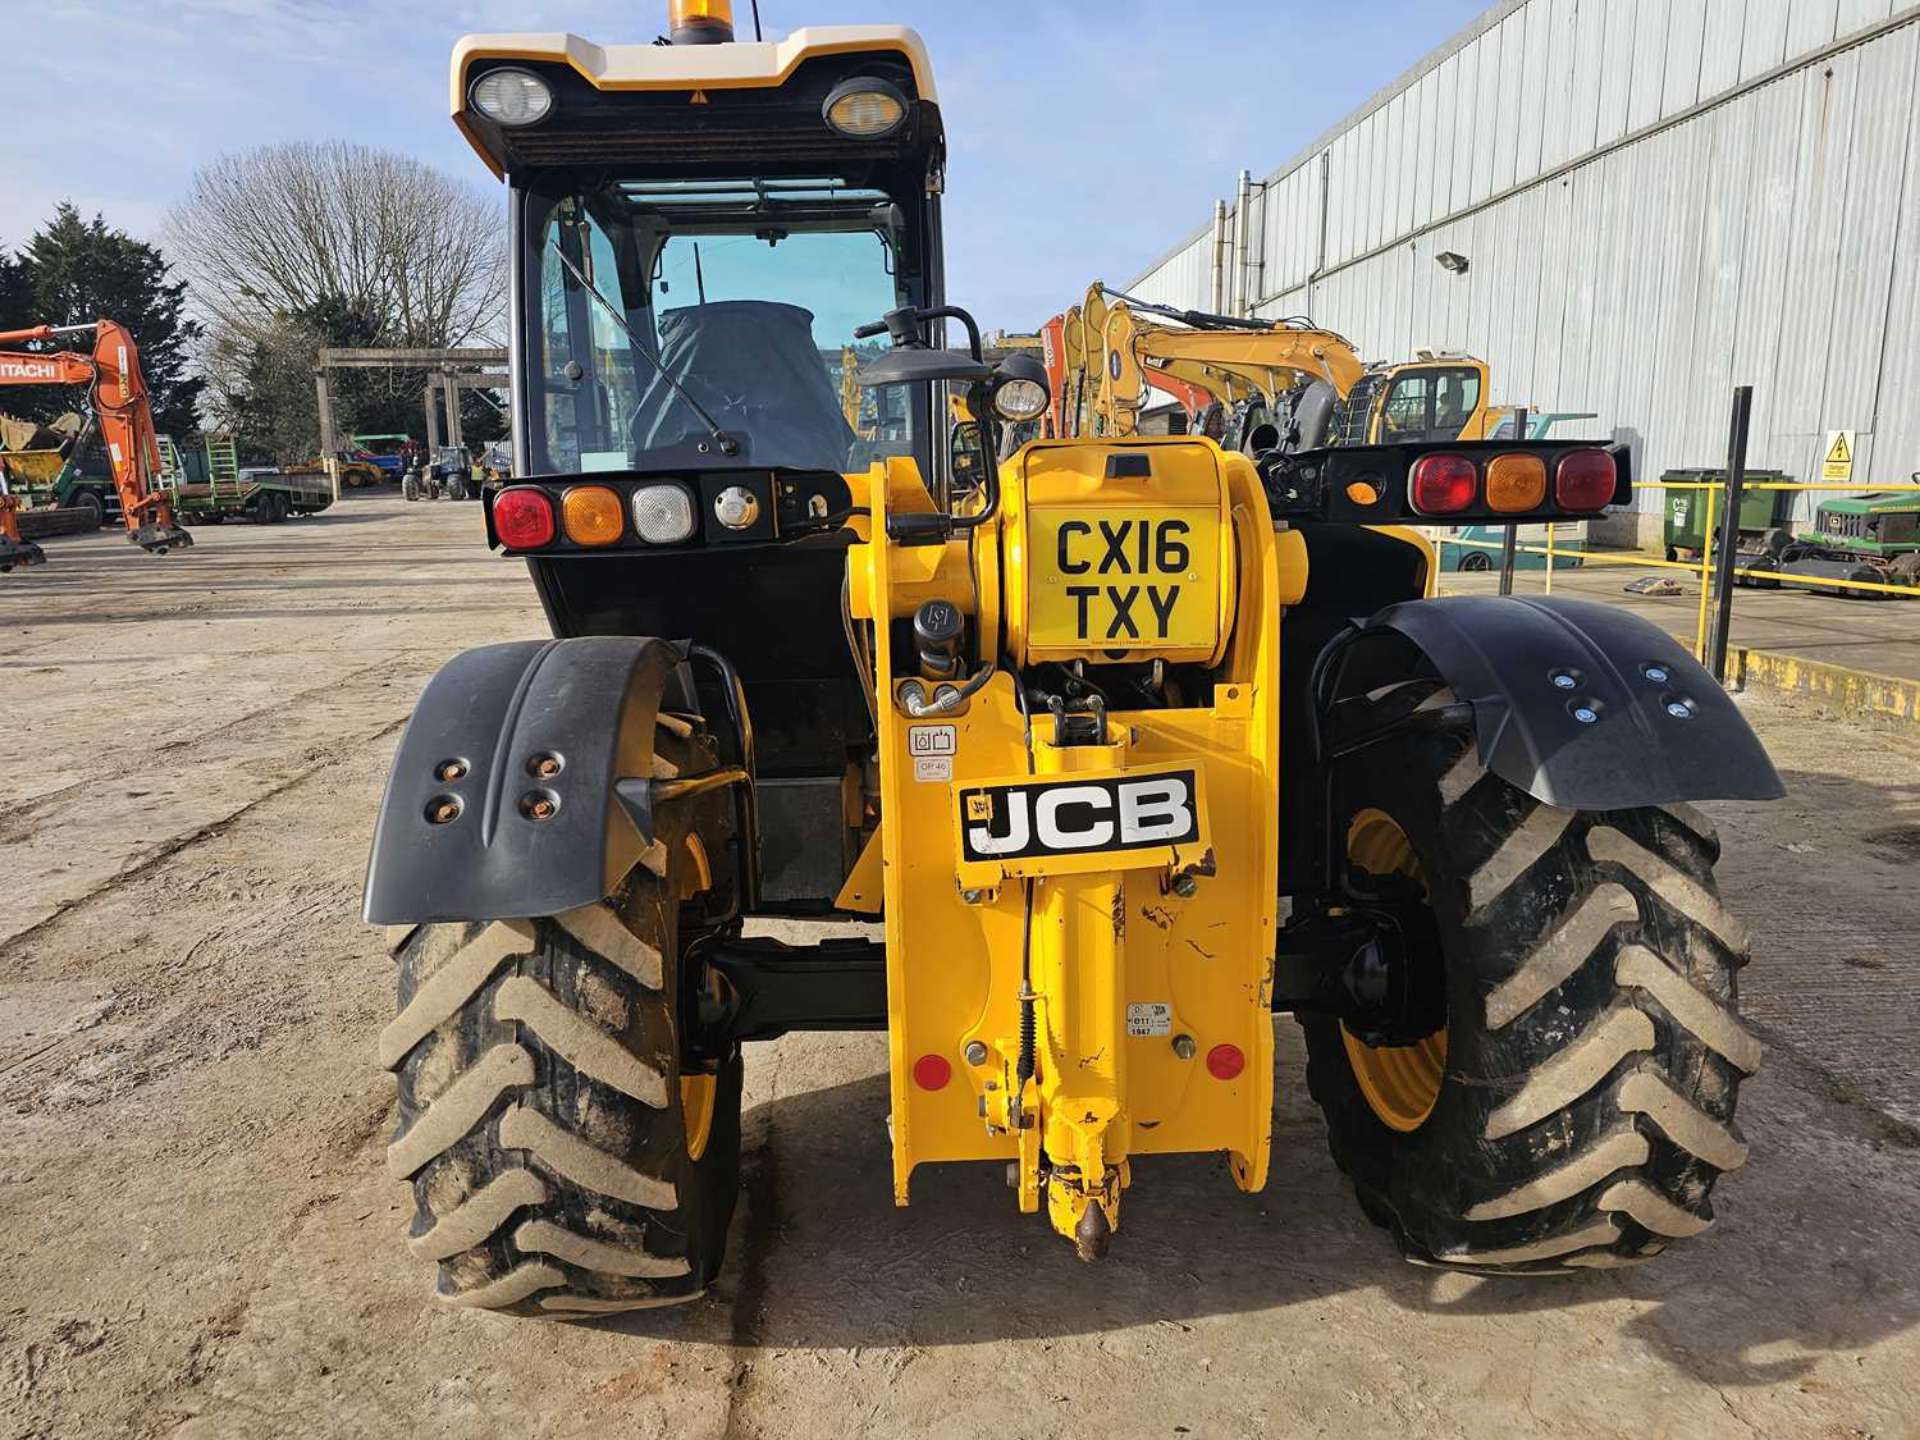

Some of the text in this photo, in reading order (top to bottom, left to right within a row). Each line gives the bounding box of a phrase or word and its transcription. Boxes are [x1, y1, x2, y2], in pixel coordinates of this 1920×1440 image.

[0, 363, 55, 377] ITACHI
[1057, 520, 1190, 574] CX16
[1066, 585, 1180, 639] TXY
[968, 778, 1192, 854] JCB
